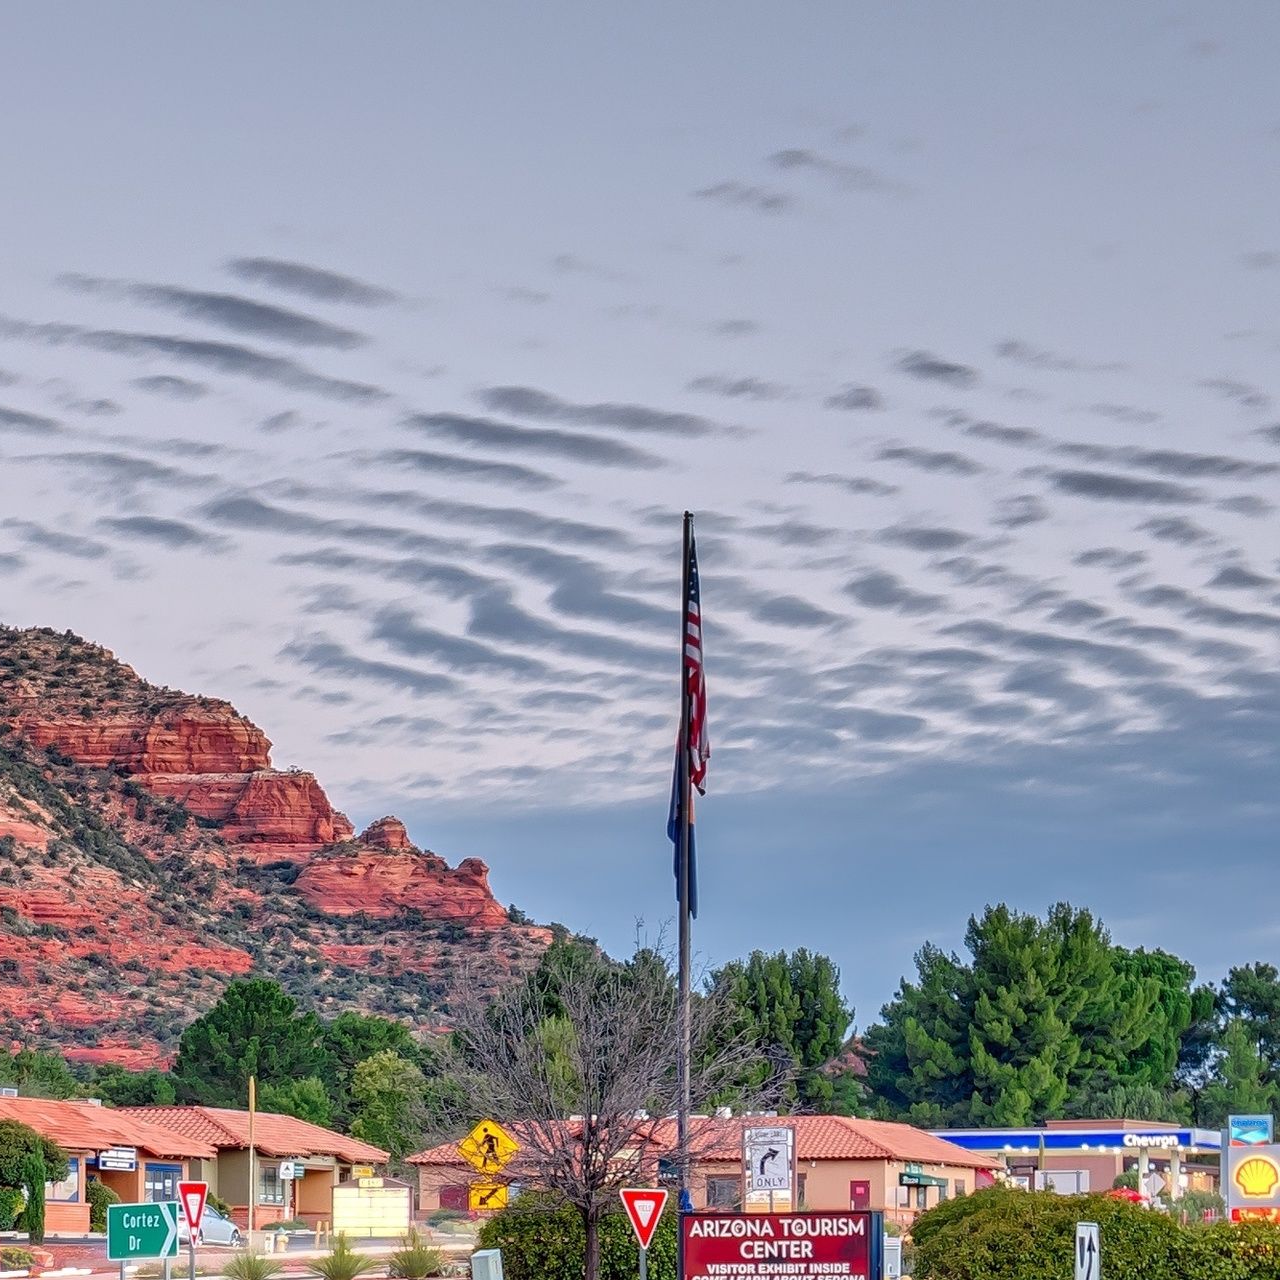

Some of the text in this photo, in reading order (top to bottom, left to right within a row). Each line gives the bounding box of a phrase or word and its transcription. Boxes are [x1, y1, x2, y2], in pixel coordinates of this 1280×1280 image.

[1123, 1134, 1179, 1147] Chevron
[757, 1177, 784, 1188] ONLY
[123, 1212, 160, 1229] Cortez
[689, 1217, 865, 1238] ARIZONA TOURISM
[129, 1235, 142, 1251] Dr
[739, 1239, 814, 1259] CENTER
[707, 1263, 851, 1275] VISITOR EXHIBIT INSIDE
